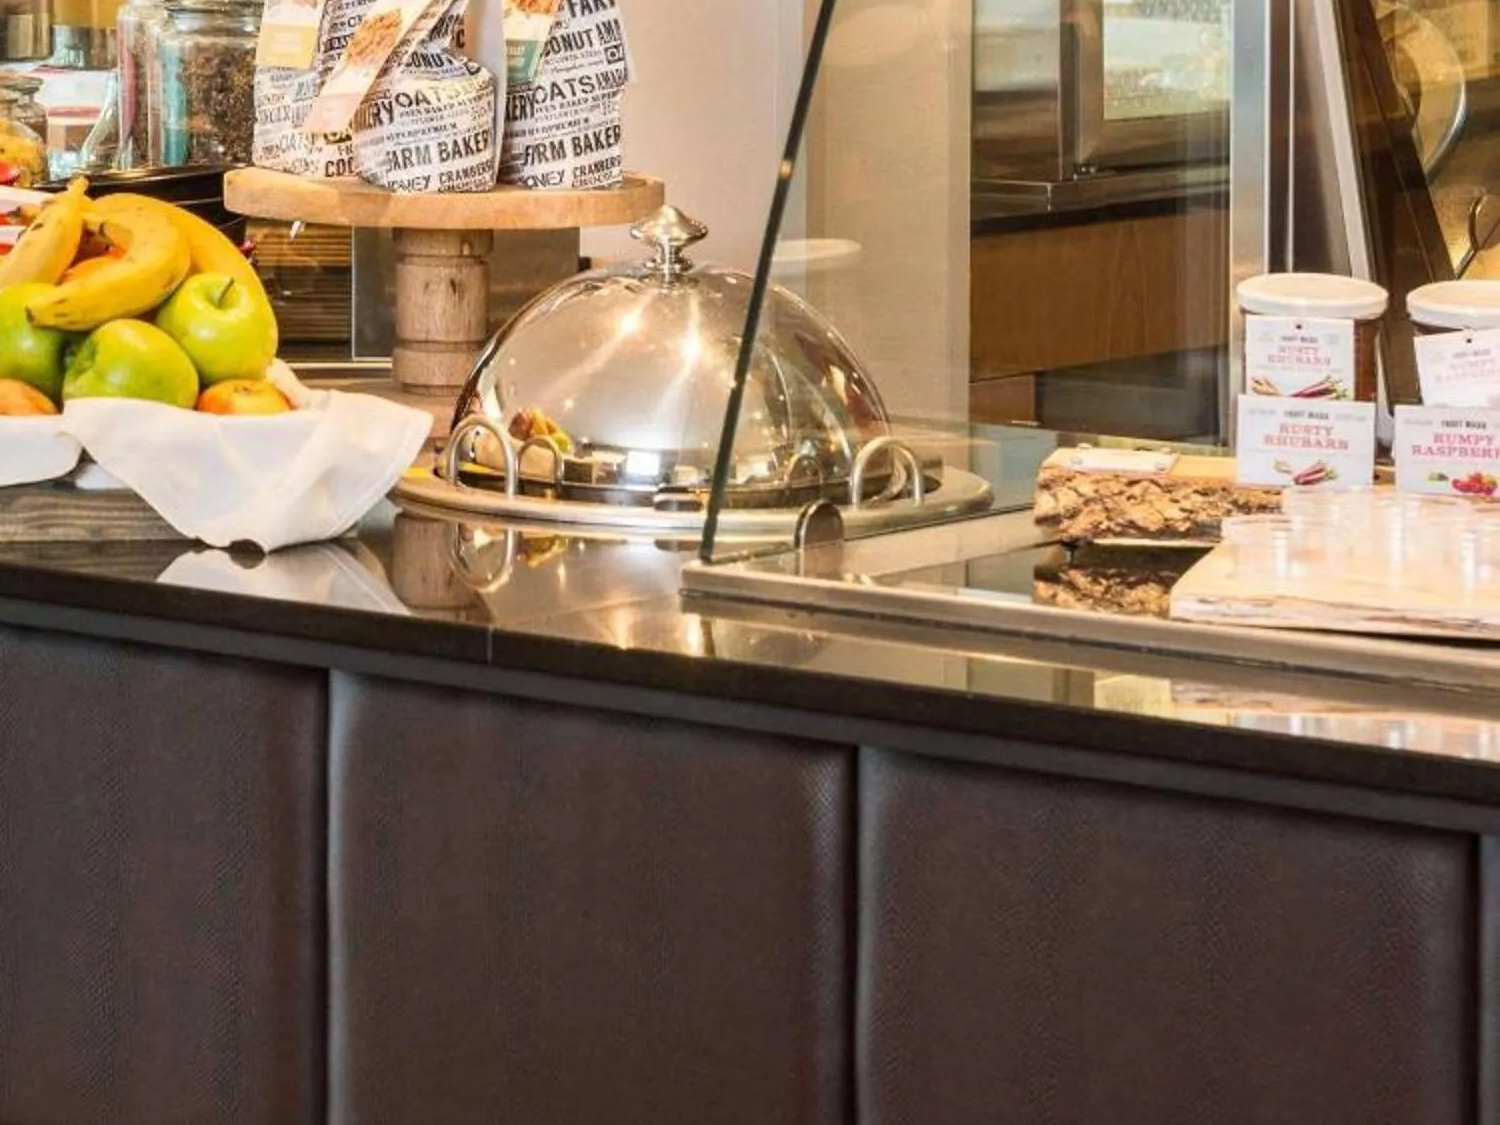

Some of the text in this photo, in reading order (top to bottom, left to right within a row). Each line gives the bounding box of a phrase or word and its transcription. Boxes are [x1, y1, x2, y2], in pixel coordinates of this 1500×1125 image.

[533, 74, 595, 104] OATS
[1278, 423, 1335, 437] RUSTY
[1263, 434, 1349, 451] RHUBARB
[1433, 432, 1496, 446] RUMPY
